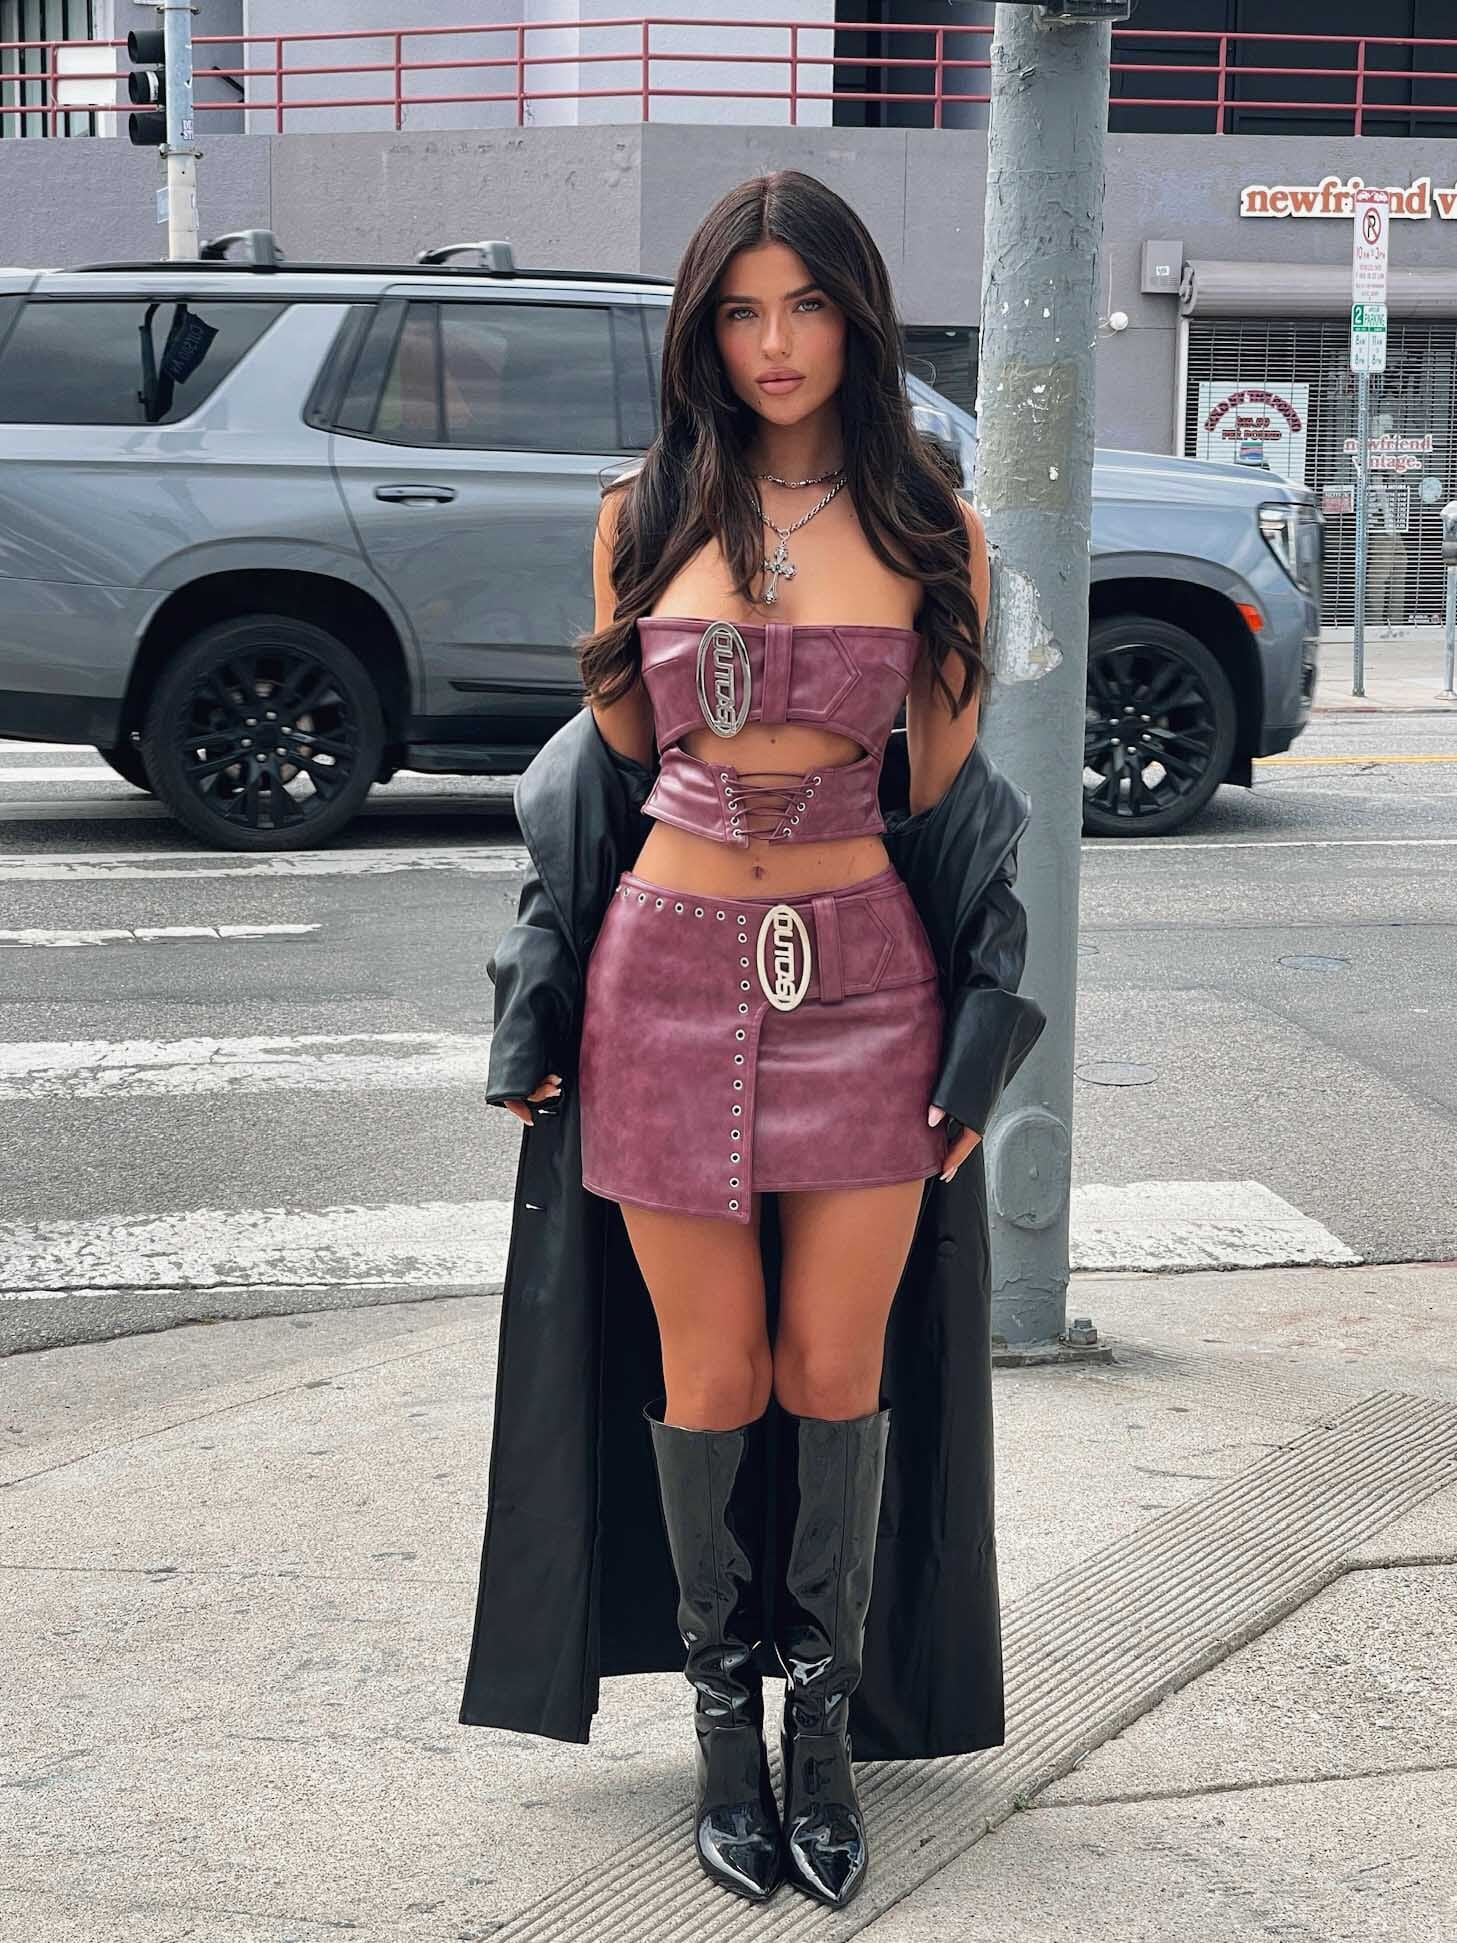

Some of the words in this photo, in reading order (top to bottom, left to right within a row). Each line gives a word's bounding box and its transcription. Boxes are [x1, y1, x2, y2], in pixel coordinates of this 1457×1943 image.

[1246, 181, 1427, 214] newfrind
[1355, 306, 1362, 324] 2
[1364, 313, 1385, 326] PARKING
[1346, 436, 1430, 449] nwfriend
[1354, 455, 1421, 471] ntage.
